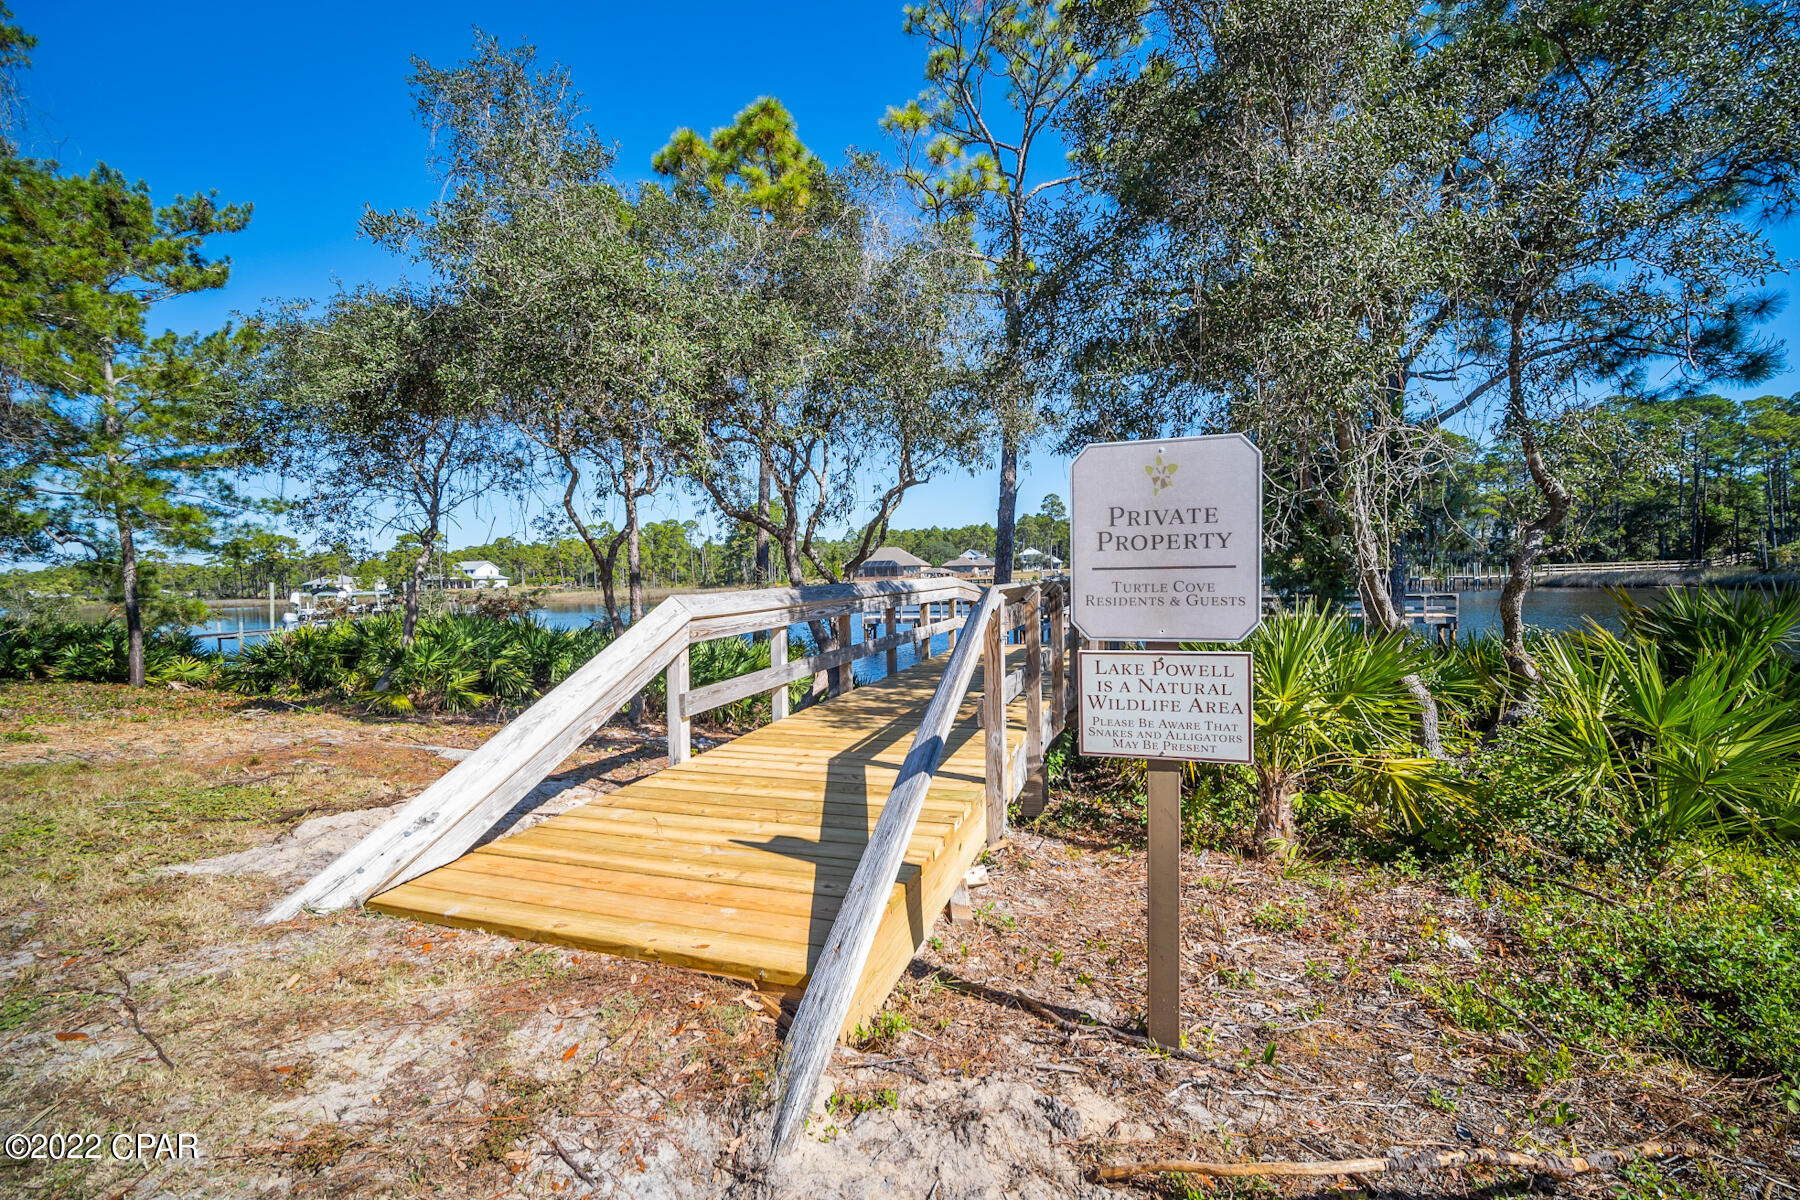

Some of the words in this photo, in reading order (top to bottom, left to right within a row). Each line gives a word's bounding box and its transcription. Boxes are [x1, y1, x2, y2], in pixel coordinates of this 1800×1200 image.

[1109, 506, 1219, 527] PRIVATE
[1096, 531, 1232, 552] PROPERTY
[1112, 581, 1168, 594] TURTLE
[1173, 580, 1216, 593] COVE
[1086, 594, 1164, 606] RESIDENTS
[1170, 596, 1180, 606] &
[1186, 594, 1246, 606] GUESTS
[1096, 660, 1144, 676] LAKE
[1152, 660, 1234, 678] POWELL
[1098, 680, 1112, 692] IS
[1120, 681, 1131, 693] A
[1138, 678, 1232, 696] NATURAL
[1087, 694, 1182, 712] WILDLIFE
[1188, 698, 1244, 714] AREA
[1092, 716, 1134, 728] PLEASE
[1139, 718, 1154, 728] BE
[1158, 719, 1200, 730] AWARE
[1204, 721, 1239, 732] THAT
[1088, 727, 1132, 738] SNAKES
[1136, 730, 1162, 740] AND
[1166, 730, 1242, 743] ALLIGATORS
[1112, 738, 1138, 750] MAY
[1143, 740, 1158, 750] BE
[1163, 741, 1217, 753] PRESENT
